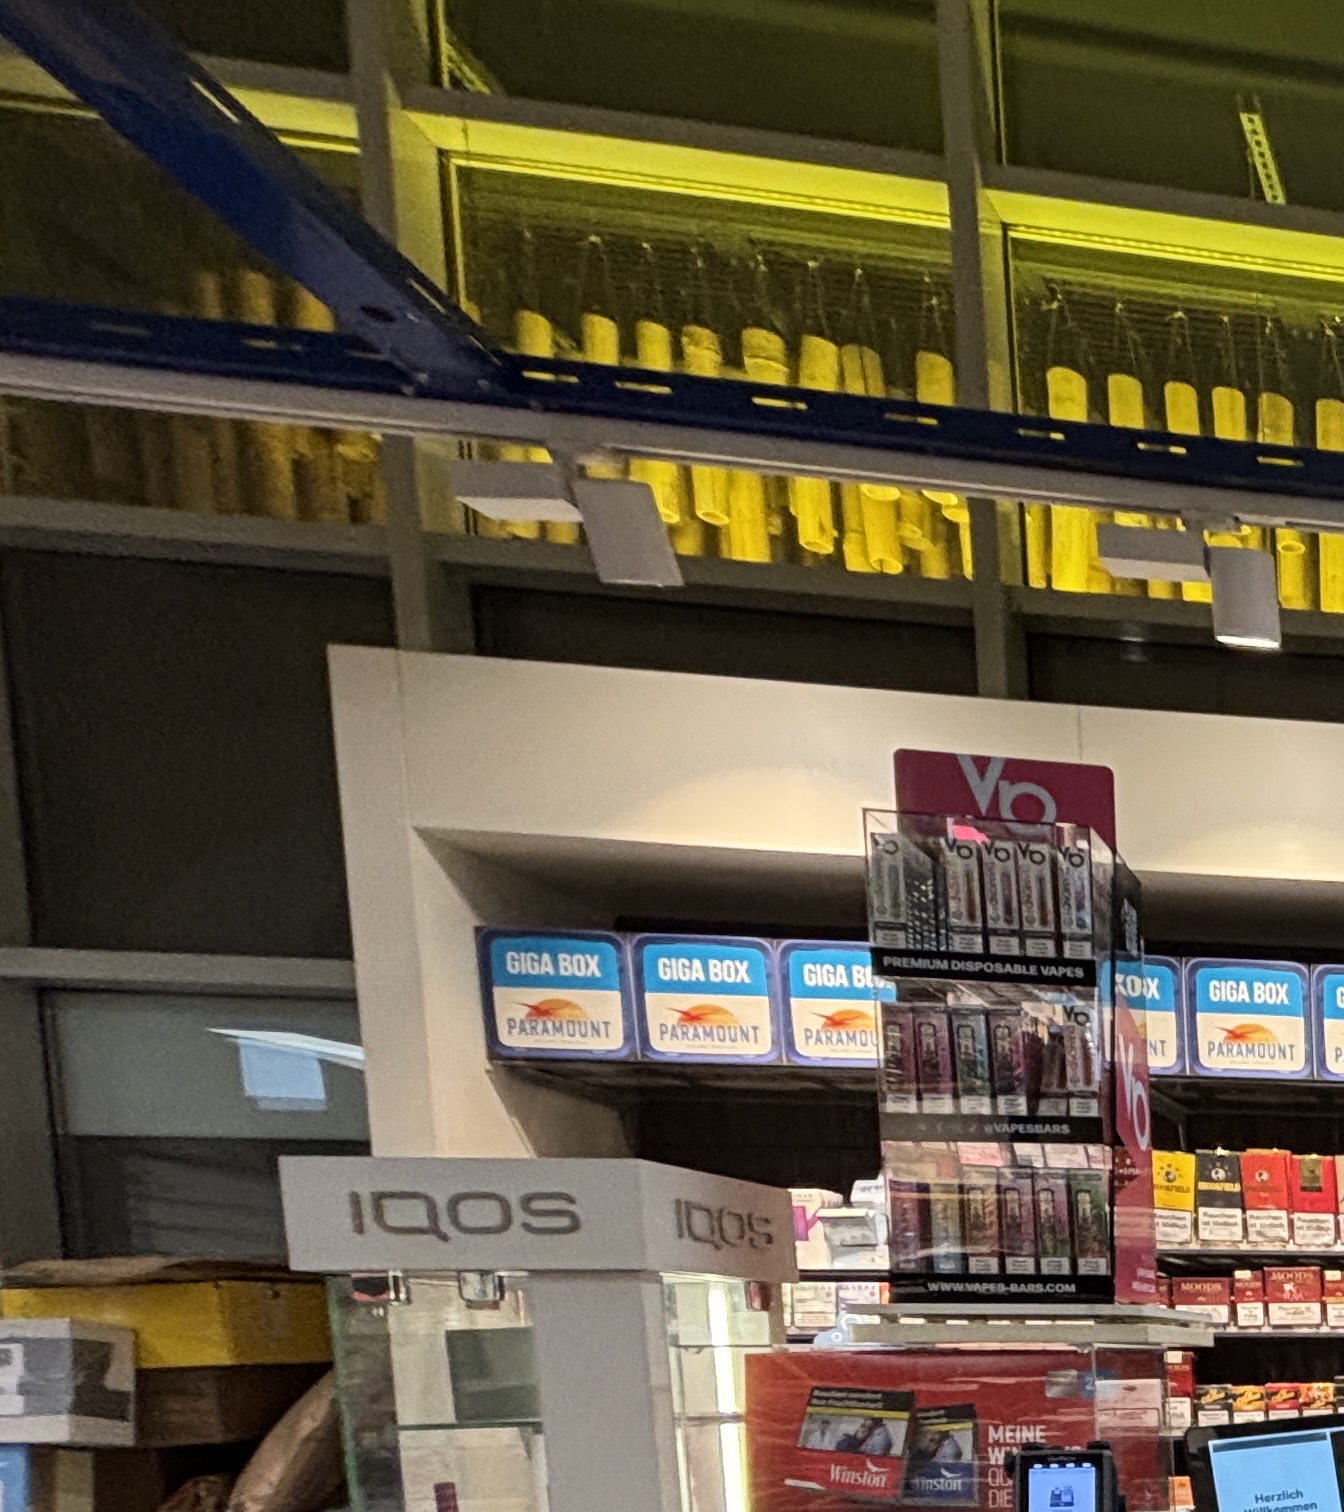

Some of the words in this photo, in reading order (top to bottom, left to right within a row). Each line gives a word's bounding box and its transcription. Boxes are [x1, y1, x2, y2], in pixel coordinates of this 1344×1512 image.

[506, 949, 553, 977] GIGA
[557, 952, 602, 979] BOX
[657, 955, 704, 982] GIGA
[707, 958, 751, 985] BOX
[802, 961, 850, 988] GIGA
[883, 956, 949, 972] PREMIUM
[951, 959, 1039, 977] DISPOSABLE
[1040, 963, 1084, 980] VAPES
[1208, 980, 1249, 1003] GIGA
[1252, 983, 1289, 1005] BOX
[506, 1016, 612, 1041] PARAMOUNT
[658, 1022, 760, 1046] PARAMOUNT
[1207, 1041, 1296, 1061] PARAMOUNT
[350, 1190, 581, 1243] IQOS
[675, 1198, 775, 1251] IQOS
[1180, 1282, 1222, 1292] MOODS
[1271, 1270, 1314, 1281] MOODS
[988, 1424, 1047, 1444] MEINE
[829, 1465, 889, 1489] Winston
[1254, 1488, 1304, 1505] Herzlich
